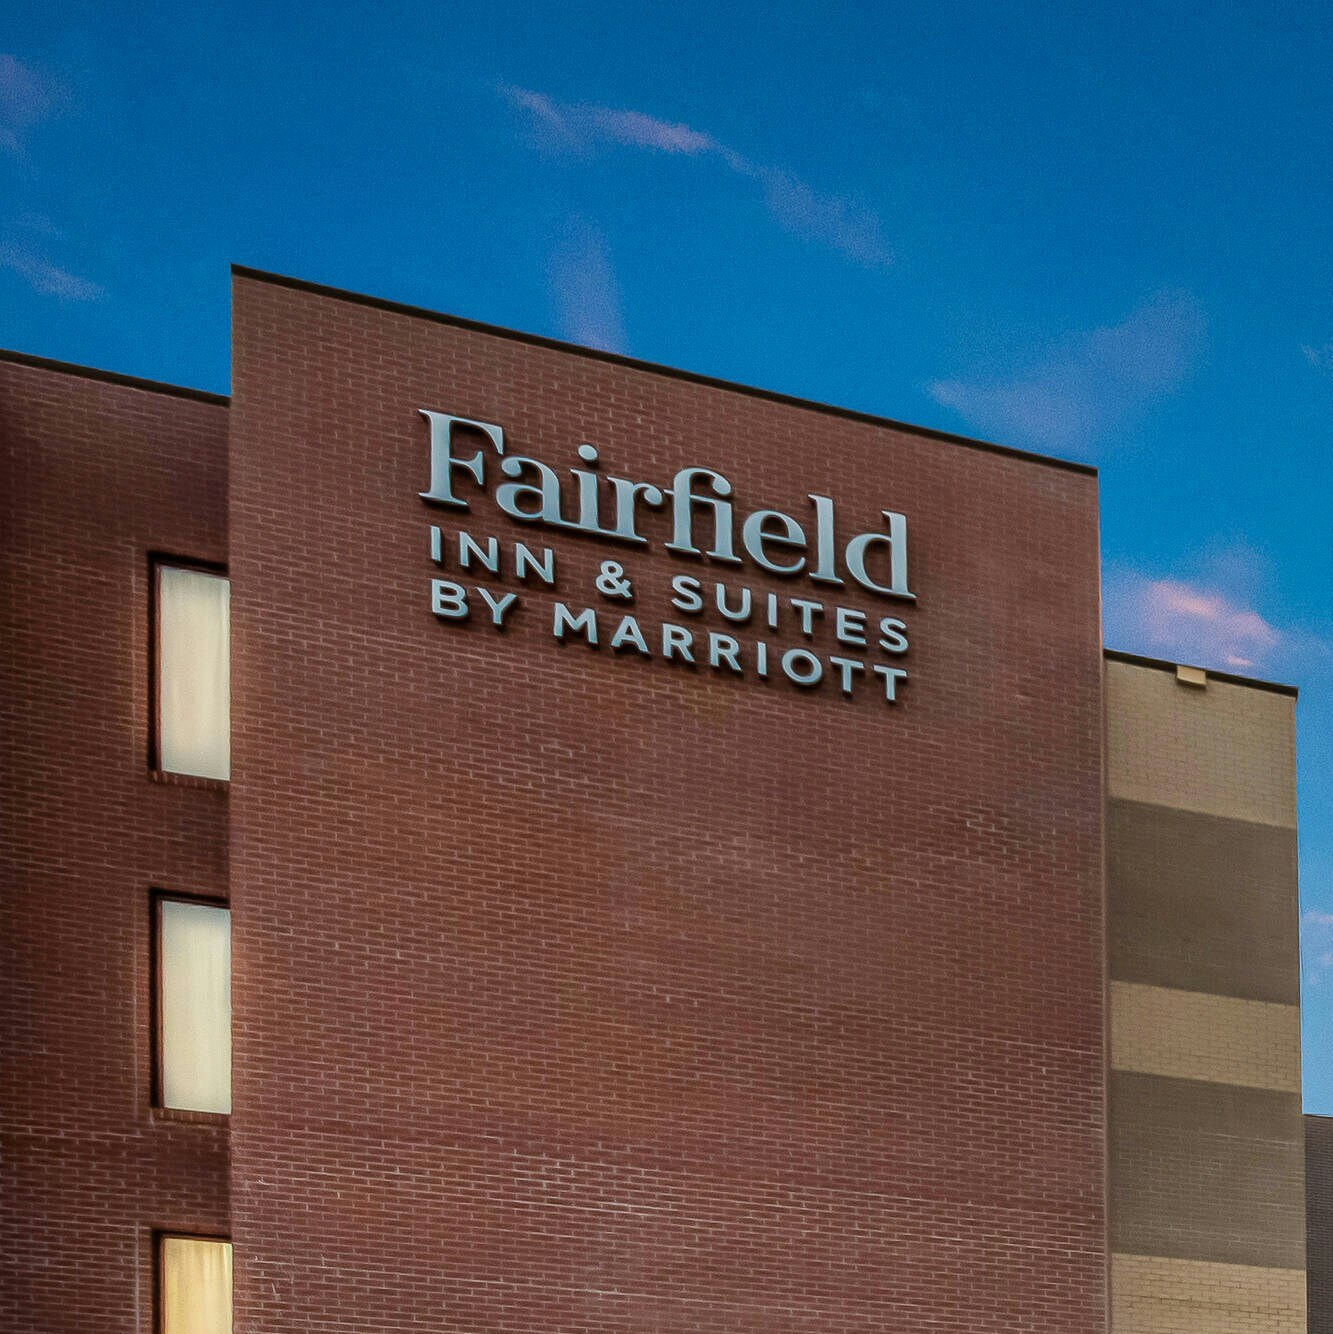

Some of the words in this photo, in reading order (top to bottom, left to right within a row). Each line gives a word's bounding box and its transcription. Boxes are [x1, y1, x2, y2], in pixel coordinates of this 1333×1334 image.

[418, 408, 918, 600] Fairfield
[429, 524, 555, 584] INN
[595, 559, 633, 600] &
[671, 574, 911, 654] SUITES
[430, 577, 518, 626] BY
[553, 601, 909, 702] MARRIOTT
